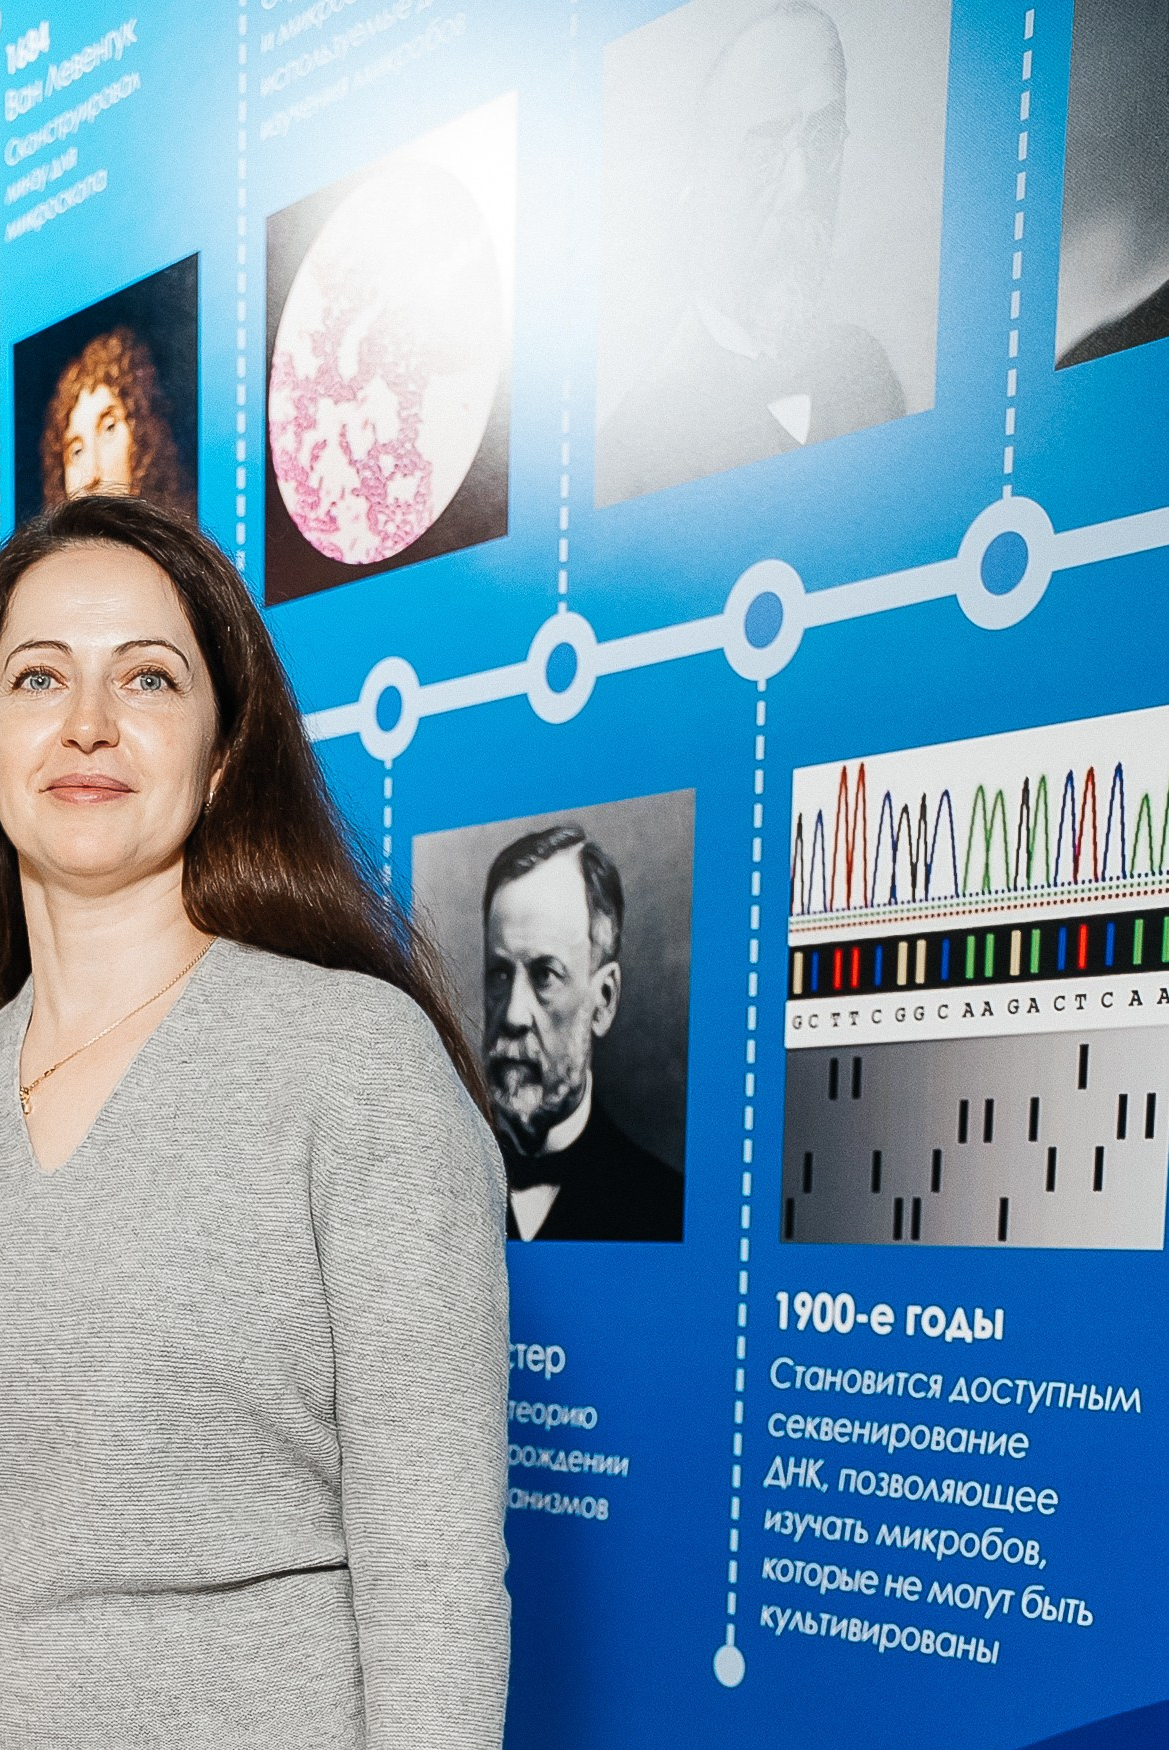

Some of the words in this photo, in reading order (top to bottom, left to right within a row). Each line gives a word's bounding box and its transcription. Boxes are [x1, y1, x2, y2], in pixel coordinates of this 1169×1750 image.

[775, 1291, 895, 1336] 1900-е
[905, 1305, 1005, 1344] годы
[769, 1356, 943, 1401] Становится
[948, 1375, 1143, 1415] доступным
[767, 1410, 1030, 1459] секвенирование
[763, 1456, 829, 1492] ДНК,
[838, 1465, 1060, 1516] позволяющее
[763, 1509, 869, 1547] изучать
[876, 1522, 1049, 1570] микробов,
[761, 1554, 879, 1597] которые
[884, 1573, 924, 1602] не
[928, 1578, 1014, 1621] могут
[1020, 1585, 1095, 1627] быть
[759, 1601, 1001, 1666] культивированы
